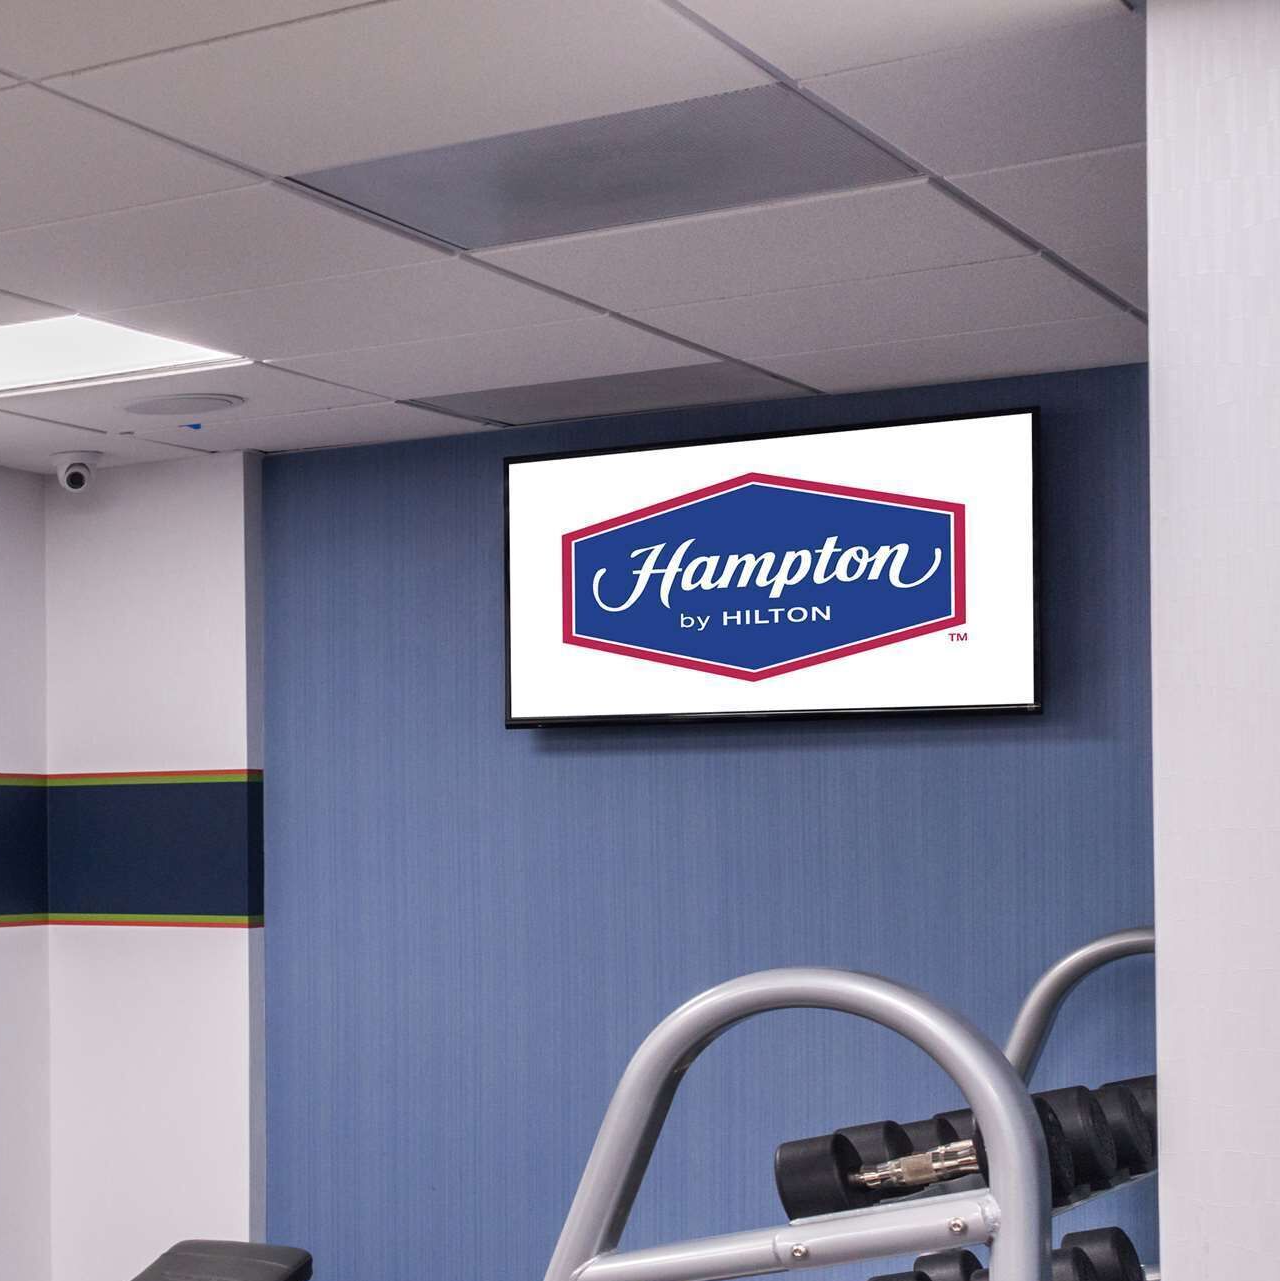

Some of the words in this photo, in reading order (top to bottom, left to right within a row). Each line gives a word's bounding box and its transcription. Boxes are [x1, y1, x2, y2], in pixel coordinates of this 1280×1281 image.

[592, 534, 943, 613] Hampton
[679, 613, 711, 632] by
[721, 605, 833, 627] HILTON
[947, 632, 969, 643] TM
